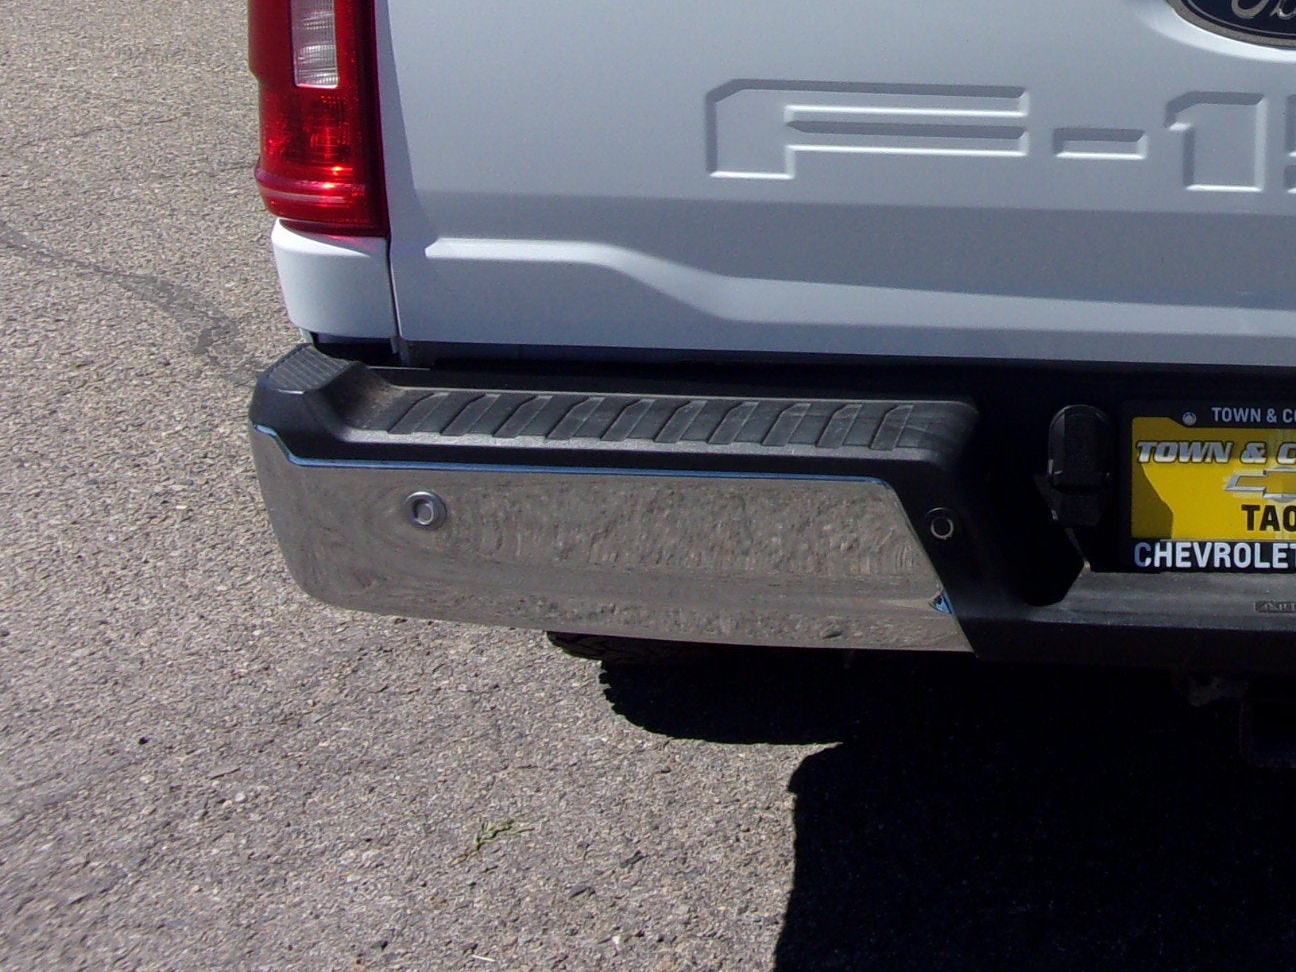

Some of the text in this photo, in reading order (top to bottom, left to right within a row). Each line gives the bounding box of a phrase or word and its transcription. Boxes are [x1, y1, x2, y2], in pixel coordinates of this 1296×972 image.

[1211, 407, 1263, 423] TOWN
[1266, 408, 1278, 423] &
[1136, 440, 1235, 464] TOWN
[1239, 441, 1269, 465] &
